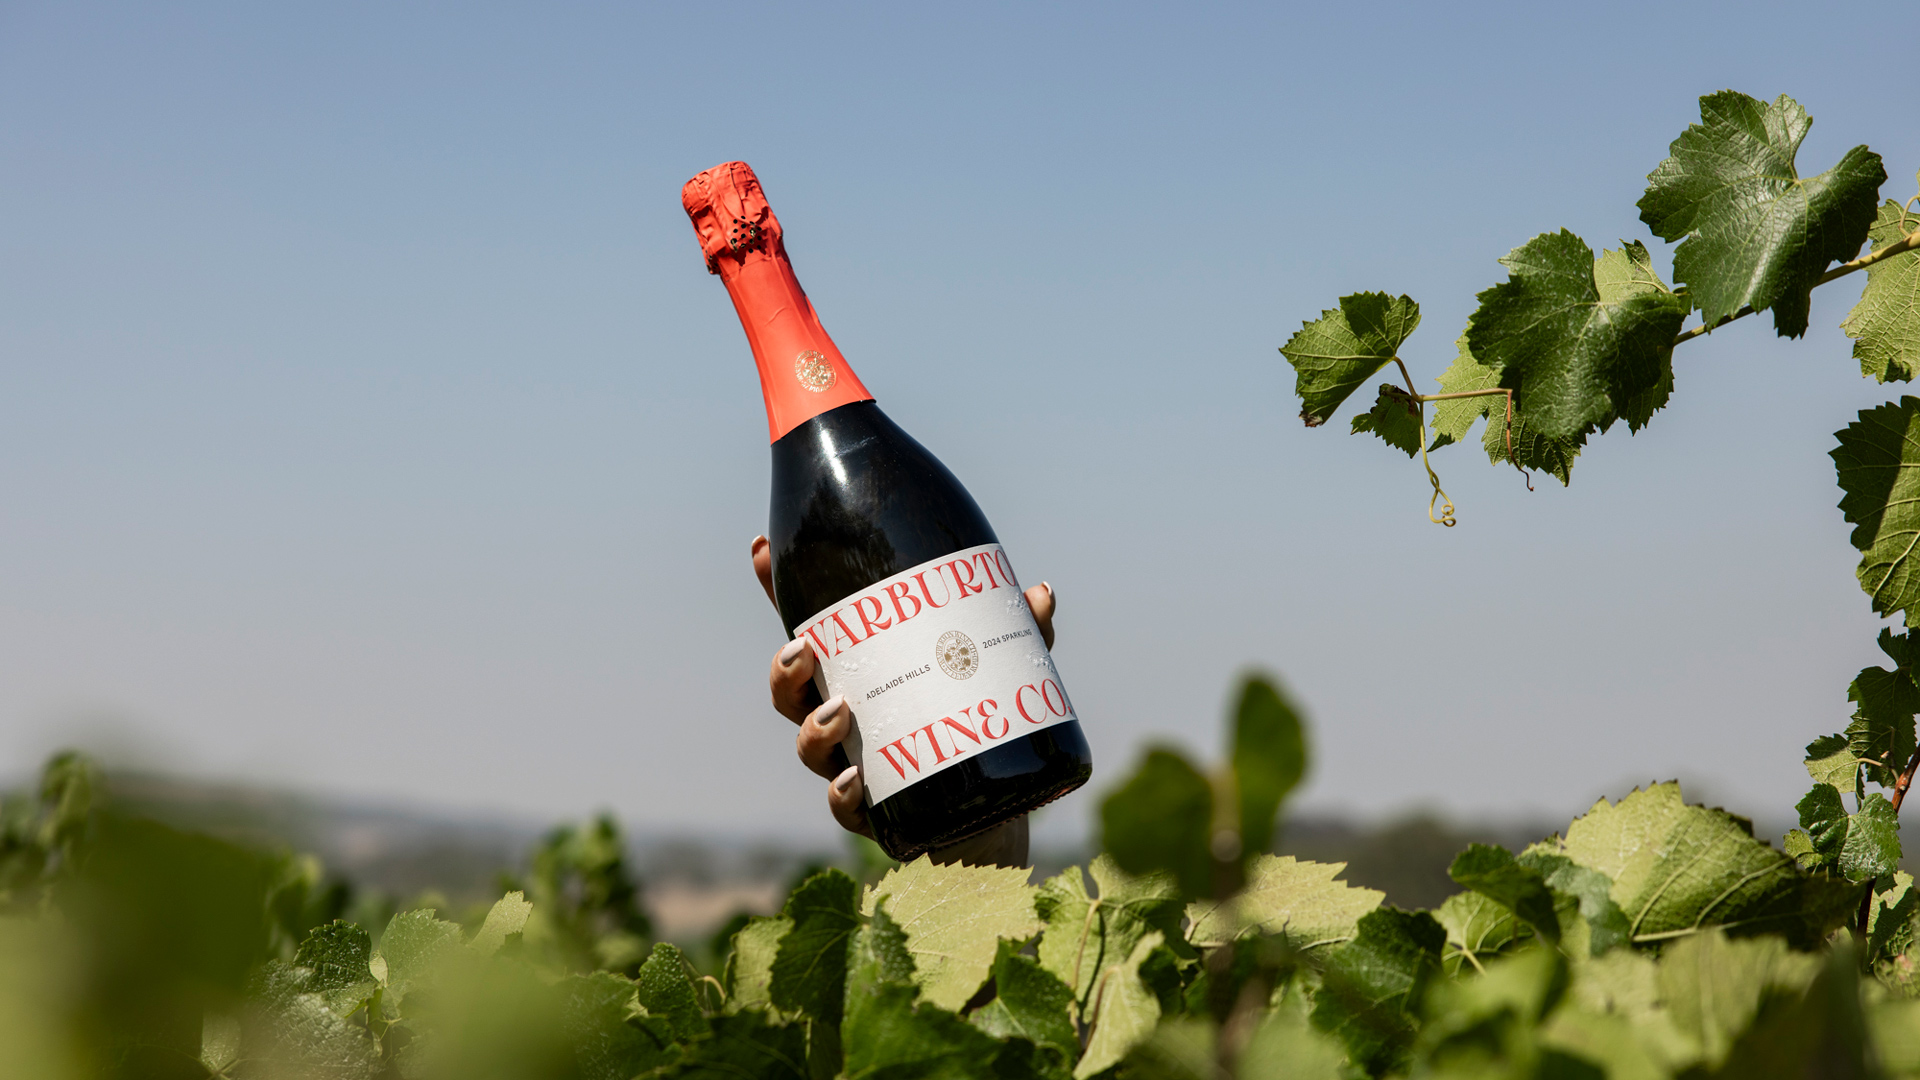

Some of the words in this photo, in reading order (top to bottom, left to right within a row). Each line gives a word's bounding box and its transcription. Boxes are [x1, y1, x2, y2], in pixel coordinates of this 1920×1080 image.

[797, 549, 1018, 665] WARBURTO
[982, 637, 1002, 649] 2024
[1001, 628, 1033, 643] SPARKLING
[866, 676, 905, 701] ADELAIDE
[905, 664, 932, 682] HILLS
[876, 698, 1010, 781] WINE
[1015, 678, 1073, 724] CO.
